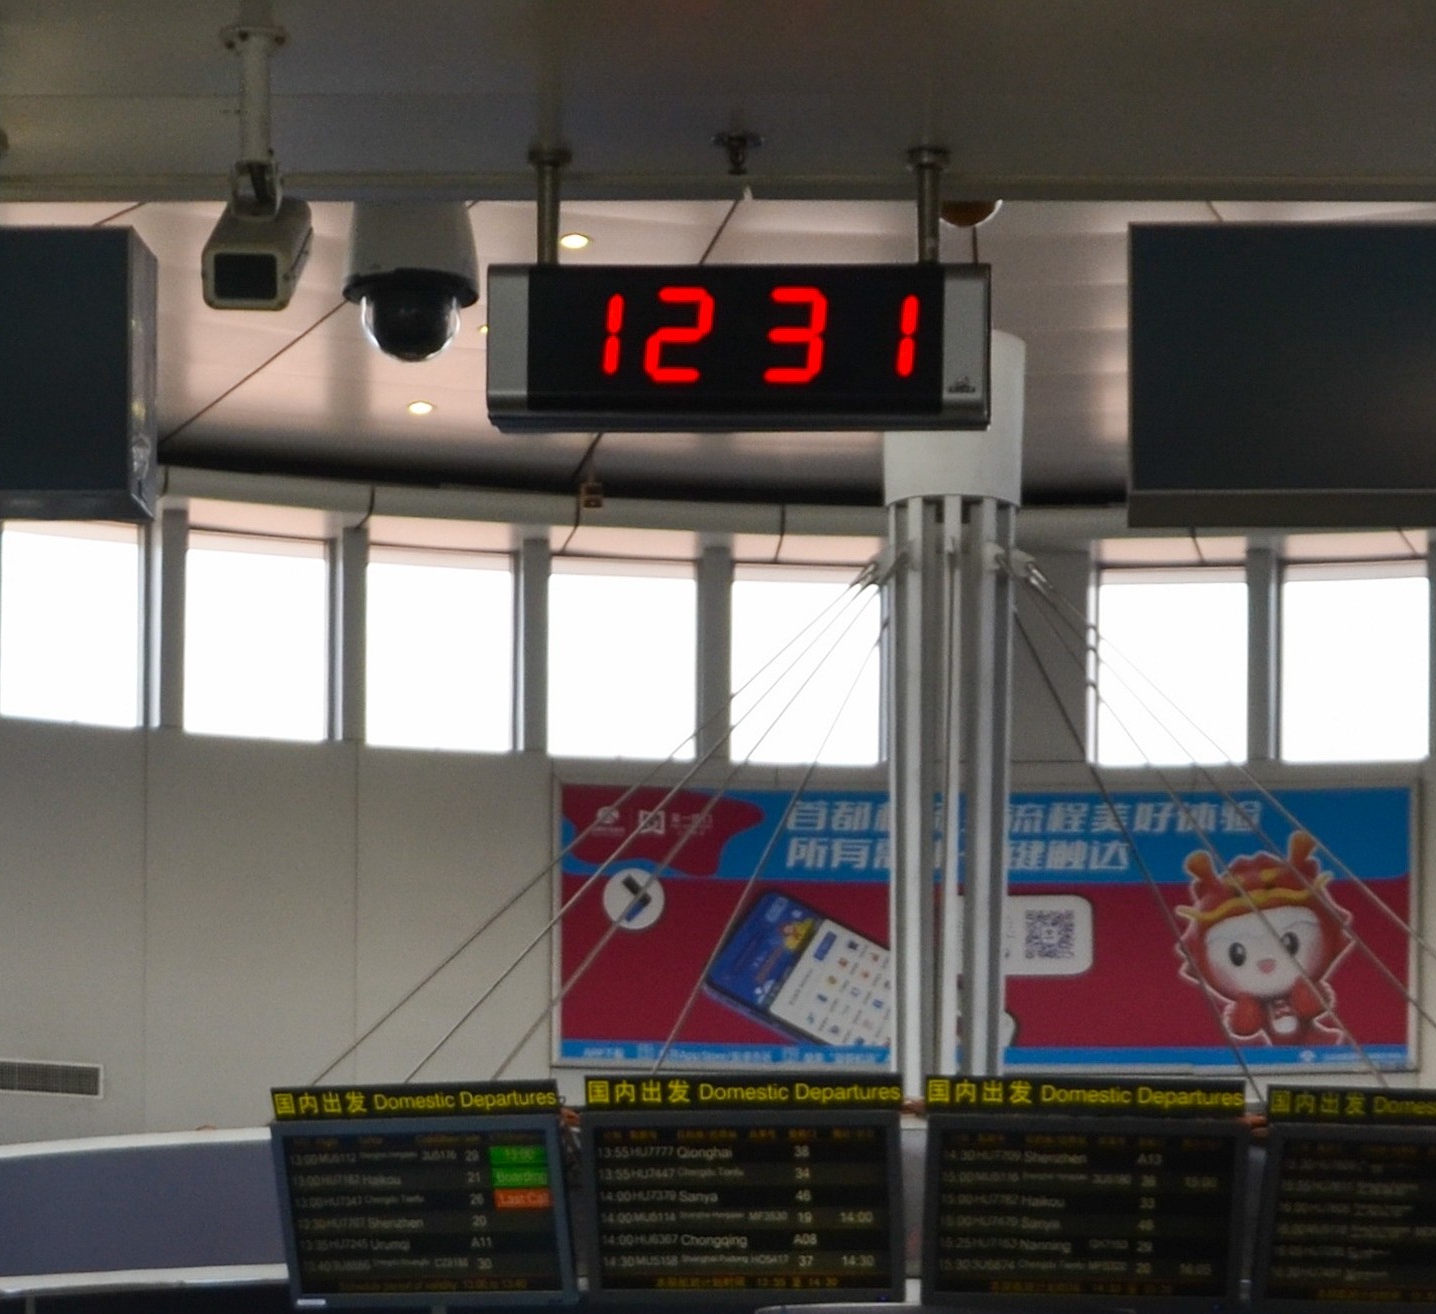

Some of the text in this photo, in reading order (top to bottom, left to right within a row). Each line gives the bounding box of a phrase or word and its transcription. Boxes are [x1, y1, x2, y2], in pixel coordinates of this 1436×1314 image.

[588, 1079, 901, 1104] 国内出发 Domestic Departures
[927, 1079, 1245, 1107] 国内出发 Domestic Departures
[274, 1090, 557, 1115] 国内出发 Domestic Departures
[1270, 1090, 1365, 1114] 国内出发
[677, 1146, 733, 1160] Qionghai
[794, 1167, 811, 1180] 34
[678, 1190, 719, 1205] Sanya
[839, 1210, 874, 1224] 14:00
[470, 1236, 493, 1249] A11
[680, 1234, 749, 1249] Chongqing
[1020, 1237, 1073, 1255] Nanning
[798, 1254, 814, 1267] 37
[842, 1254, 875, 1267] 14:30
